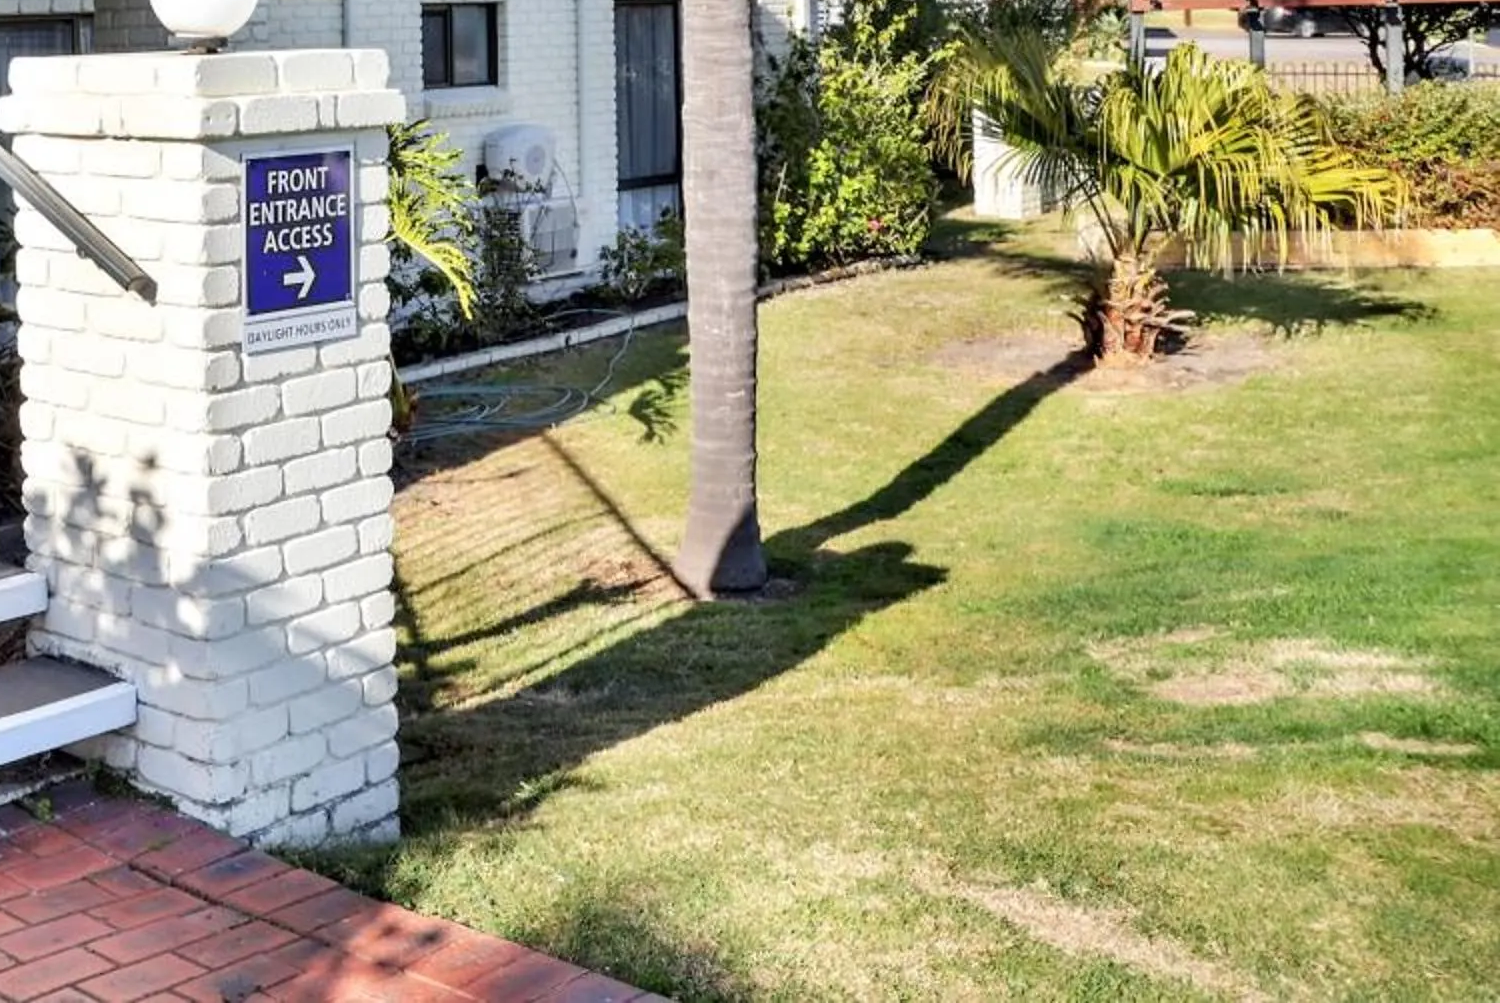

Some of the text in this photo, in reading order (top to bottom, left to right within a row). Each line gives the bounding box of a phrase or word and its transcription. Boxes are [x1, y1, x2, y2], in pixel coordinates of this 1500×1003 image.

[267, 166, 329, 194] FRONT
[250, 194, 347, 226] ENTRANCE
[263, 223, 333, 254] ACCESS
[247, 317, 351, 344] DAYLIGHT HOURS ONLY
